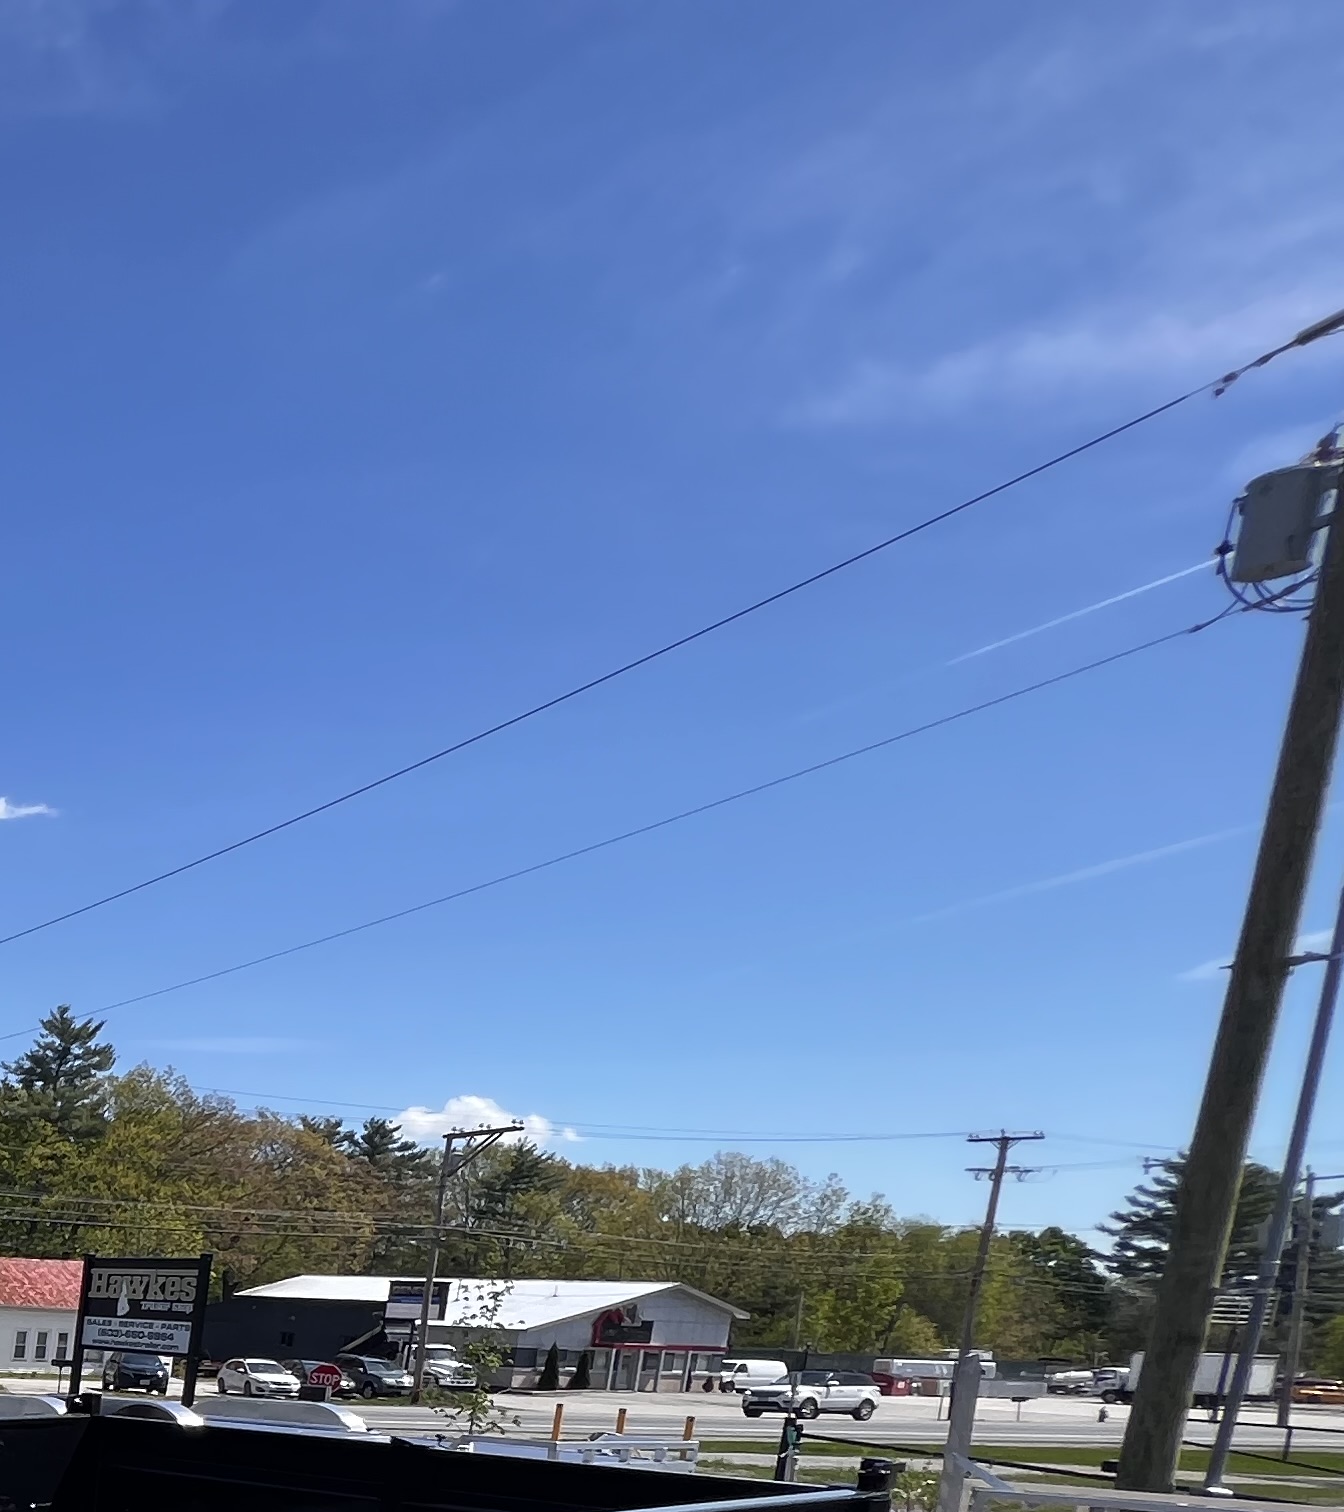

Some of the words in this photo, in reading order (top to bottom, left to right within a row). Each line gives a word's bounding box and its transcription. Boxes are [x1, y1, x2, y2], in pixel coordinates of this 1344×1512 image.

[88, 1268, 199, 1301] Hawkes
[118, 1321, 155, 1330] SERVICE
[160, 1323, 191, 1333] PARTS
[309, 1372, 340, 1386] STOP
